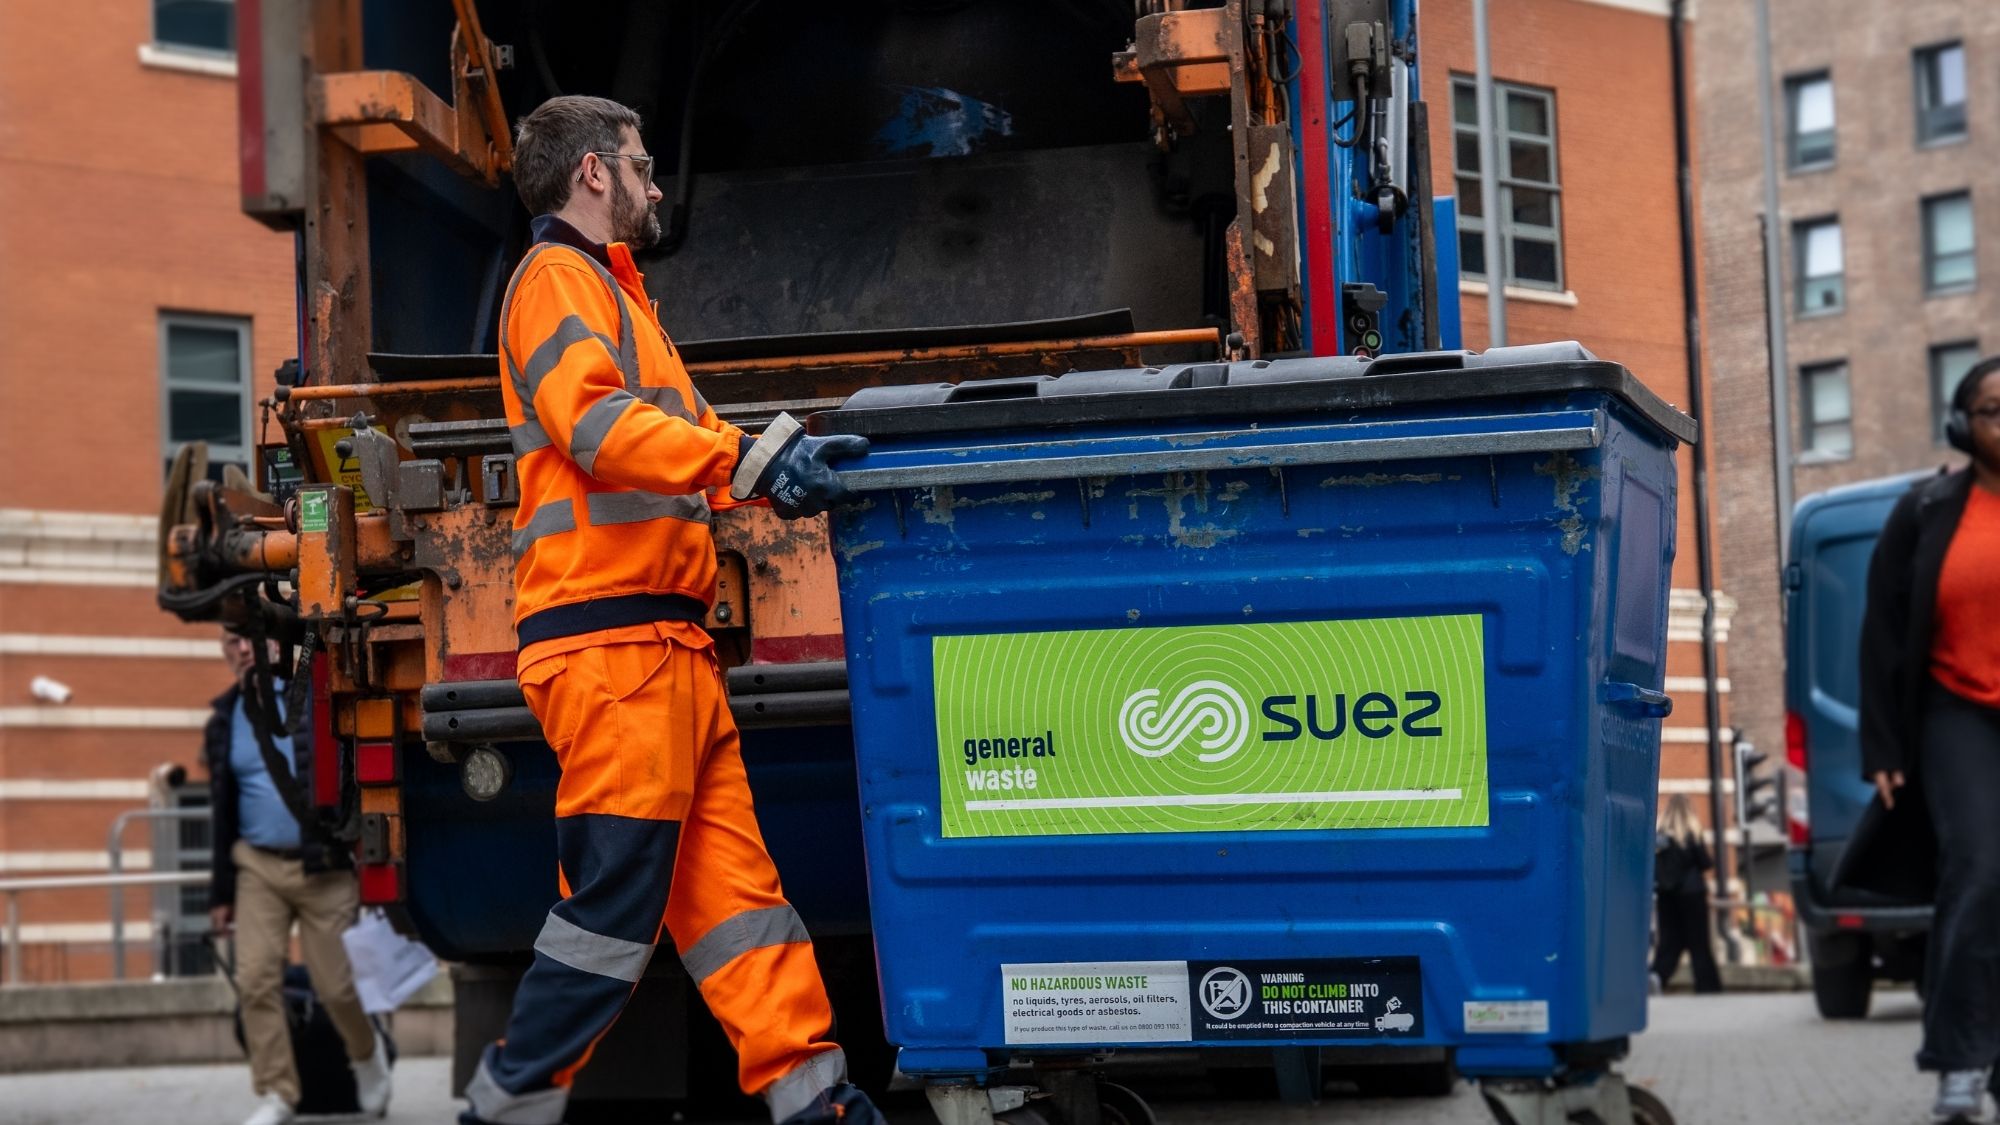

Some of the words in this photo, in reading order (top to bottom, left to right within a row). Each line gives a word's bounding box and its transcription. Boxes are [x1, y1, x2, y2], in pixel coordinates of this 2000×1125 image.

[1261, 691, 1443, 741] suez
[964, 730, 1056, 765] general
[964, 765, 1037, 791] waste
[1011, 977, 1027, 991] NO
[1030, 976, 1102, 991] HAZARDOUS
[1104, 975, 1149, 990] WASTE
[1260, 973, 1305, 984] WARNING
[1262, 985, 1279, 999] DO
[1281, 984, 1306, 999] NOT
[1308, 983, 1348, 999] CLIMB
[1350, 983, 1380, 998] INTO
[1025, 996, 1059, 1007] liquids,
[1060, 996, 1087, 1006] tyres,
[1088, 995, 1131, 1005] aerosols,
[1132, 994, 1145, 1003] oil
[1146, 994, 1178, 1004] filters,
[1262, 1000, 1292, 1015] THIS
[1293, 999, 1365, 1014] CONTAINER
[1012, 1008, 1055, 1017] electrical
[1056, 1007, 1084, 1018] goods
[1085, 1008, 1096, 1016] or
[1097, 1007, 1142, 1016] asbestos.
[1237, 1022, 1262, 1030] emptied
[1280, 1021, 1314, 1029] compaction
[1355, 1020, 1369, 1028] time
